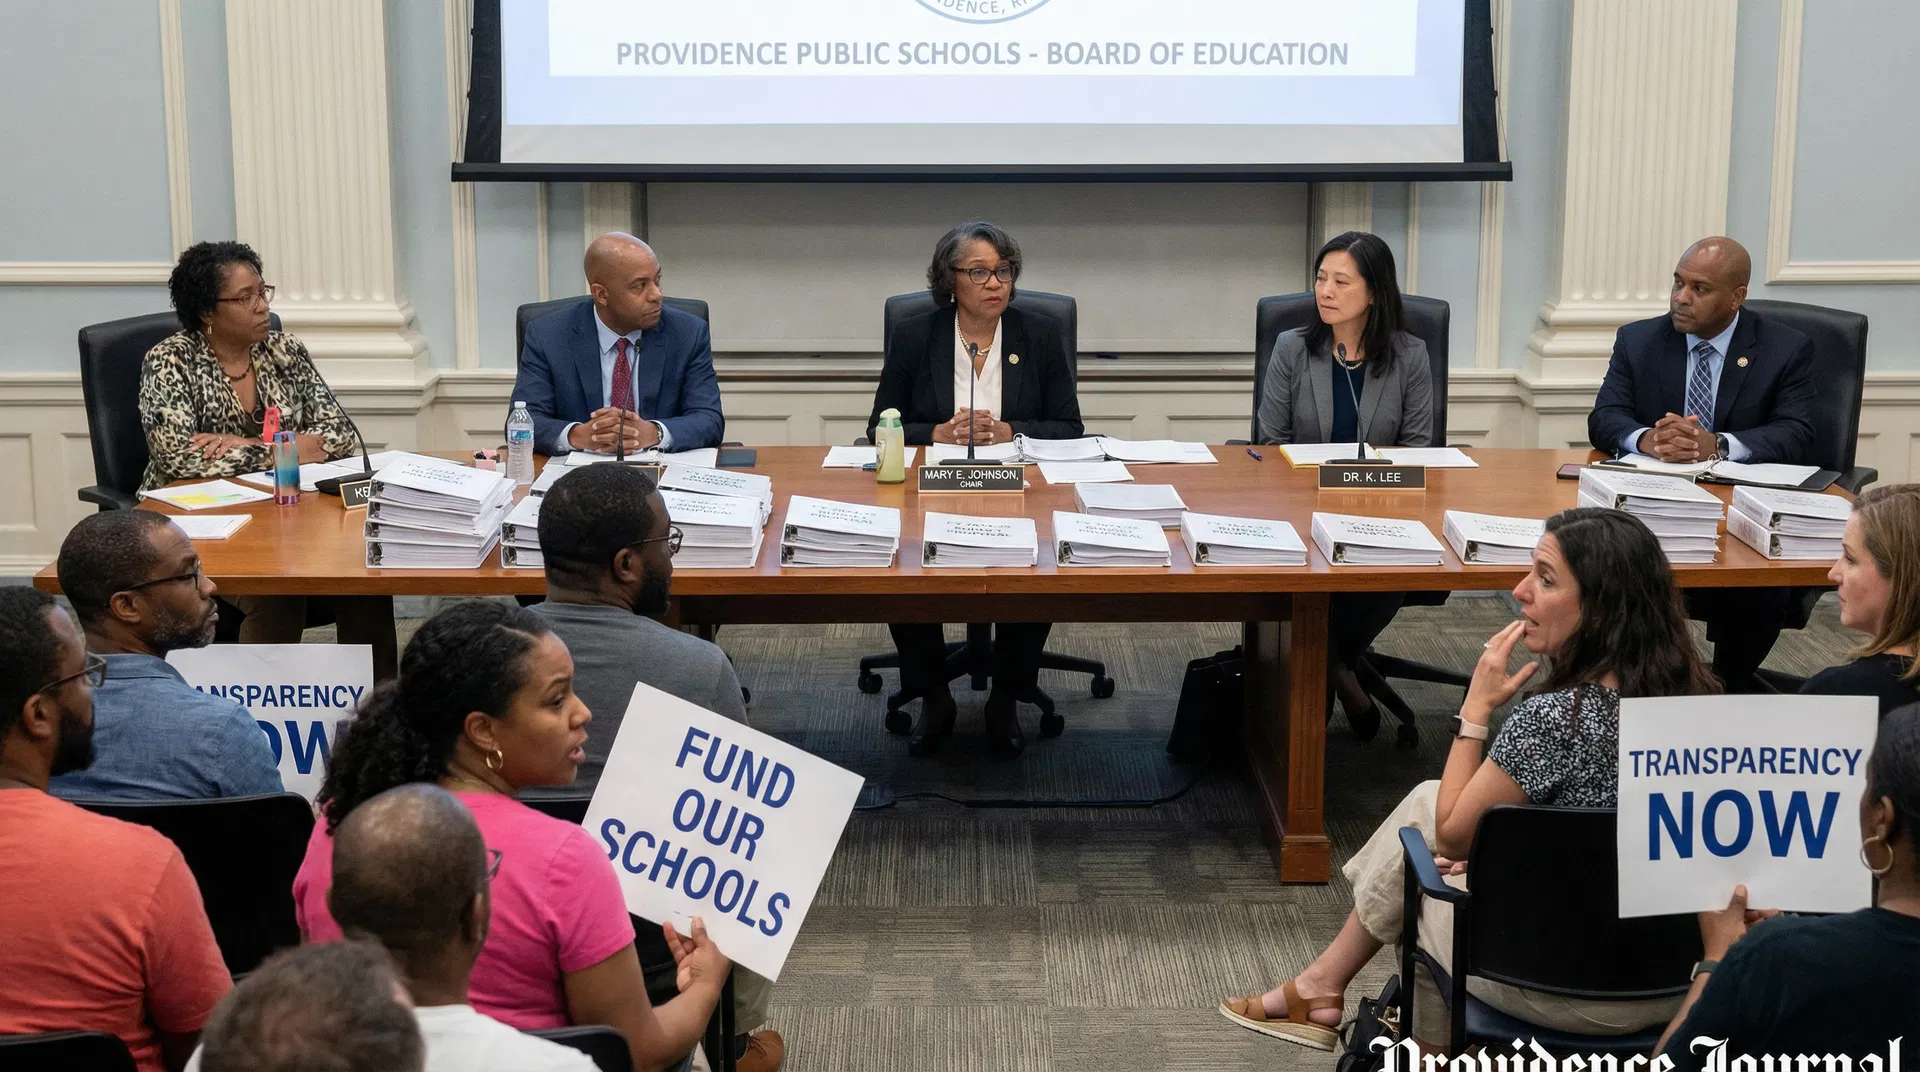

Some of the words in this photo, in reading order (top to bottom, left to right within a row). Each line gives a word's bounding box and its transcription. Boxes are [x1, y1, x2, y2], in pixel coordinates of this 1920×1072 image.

[937, 0, 1005, 14] DENCE,
[617, 41, 787, 66] PROVIDENCE
[797, 41, 890, 66] PUBLIC
[898, 41, 1021, 66] SCHOOLS
[1047, 41, 1141, 66] BOARD
[1150, 41, 1184, 66] OF
[1194, 41, 1349, 66] EDUCATION
[925, 470, 953, 480] MARY
[956, 470, 965, 480] E.
[968, 470, 1019, 481] JOHNSON,
[1343, 472, 1363, 482] DR.
[1365, 472, 1376, 482] K.
[1380, 472, 1402, 483] LEE
[675, 726, 795, 808] FUND
[1629, 747, 1862, 777] TRANSPARENCY
[672, 789, 764, 861] OUR
[1649, 789, 1840, 861] NOW
[600, 818, 790, 937] SCHOOLS
